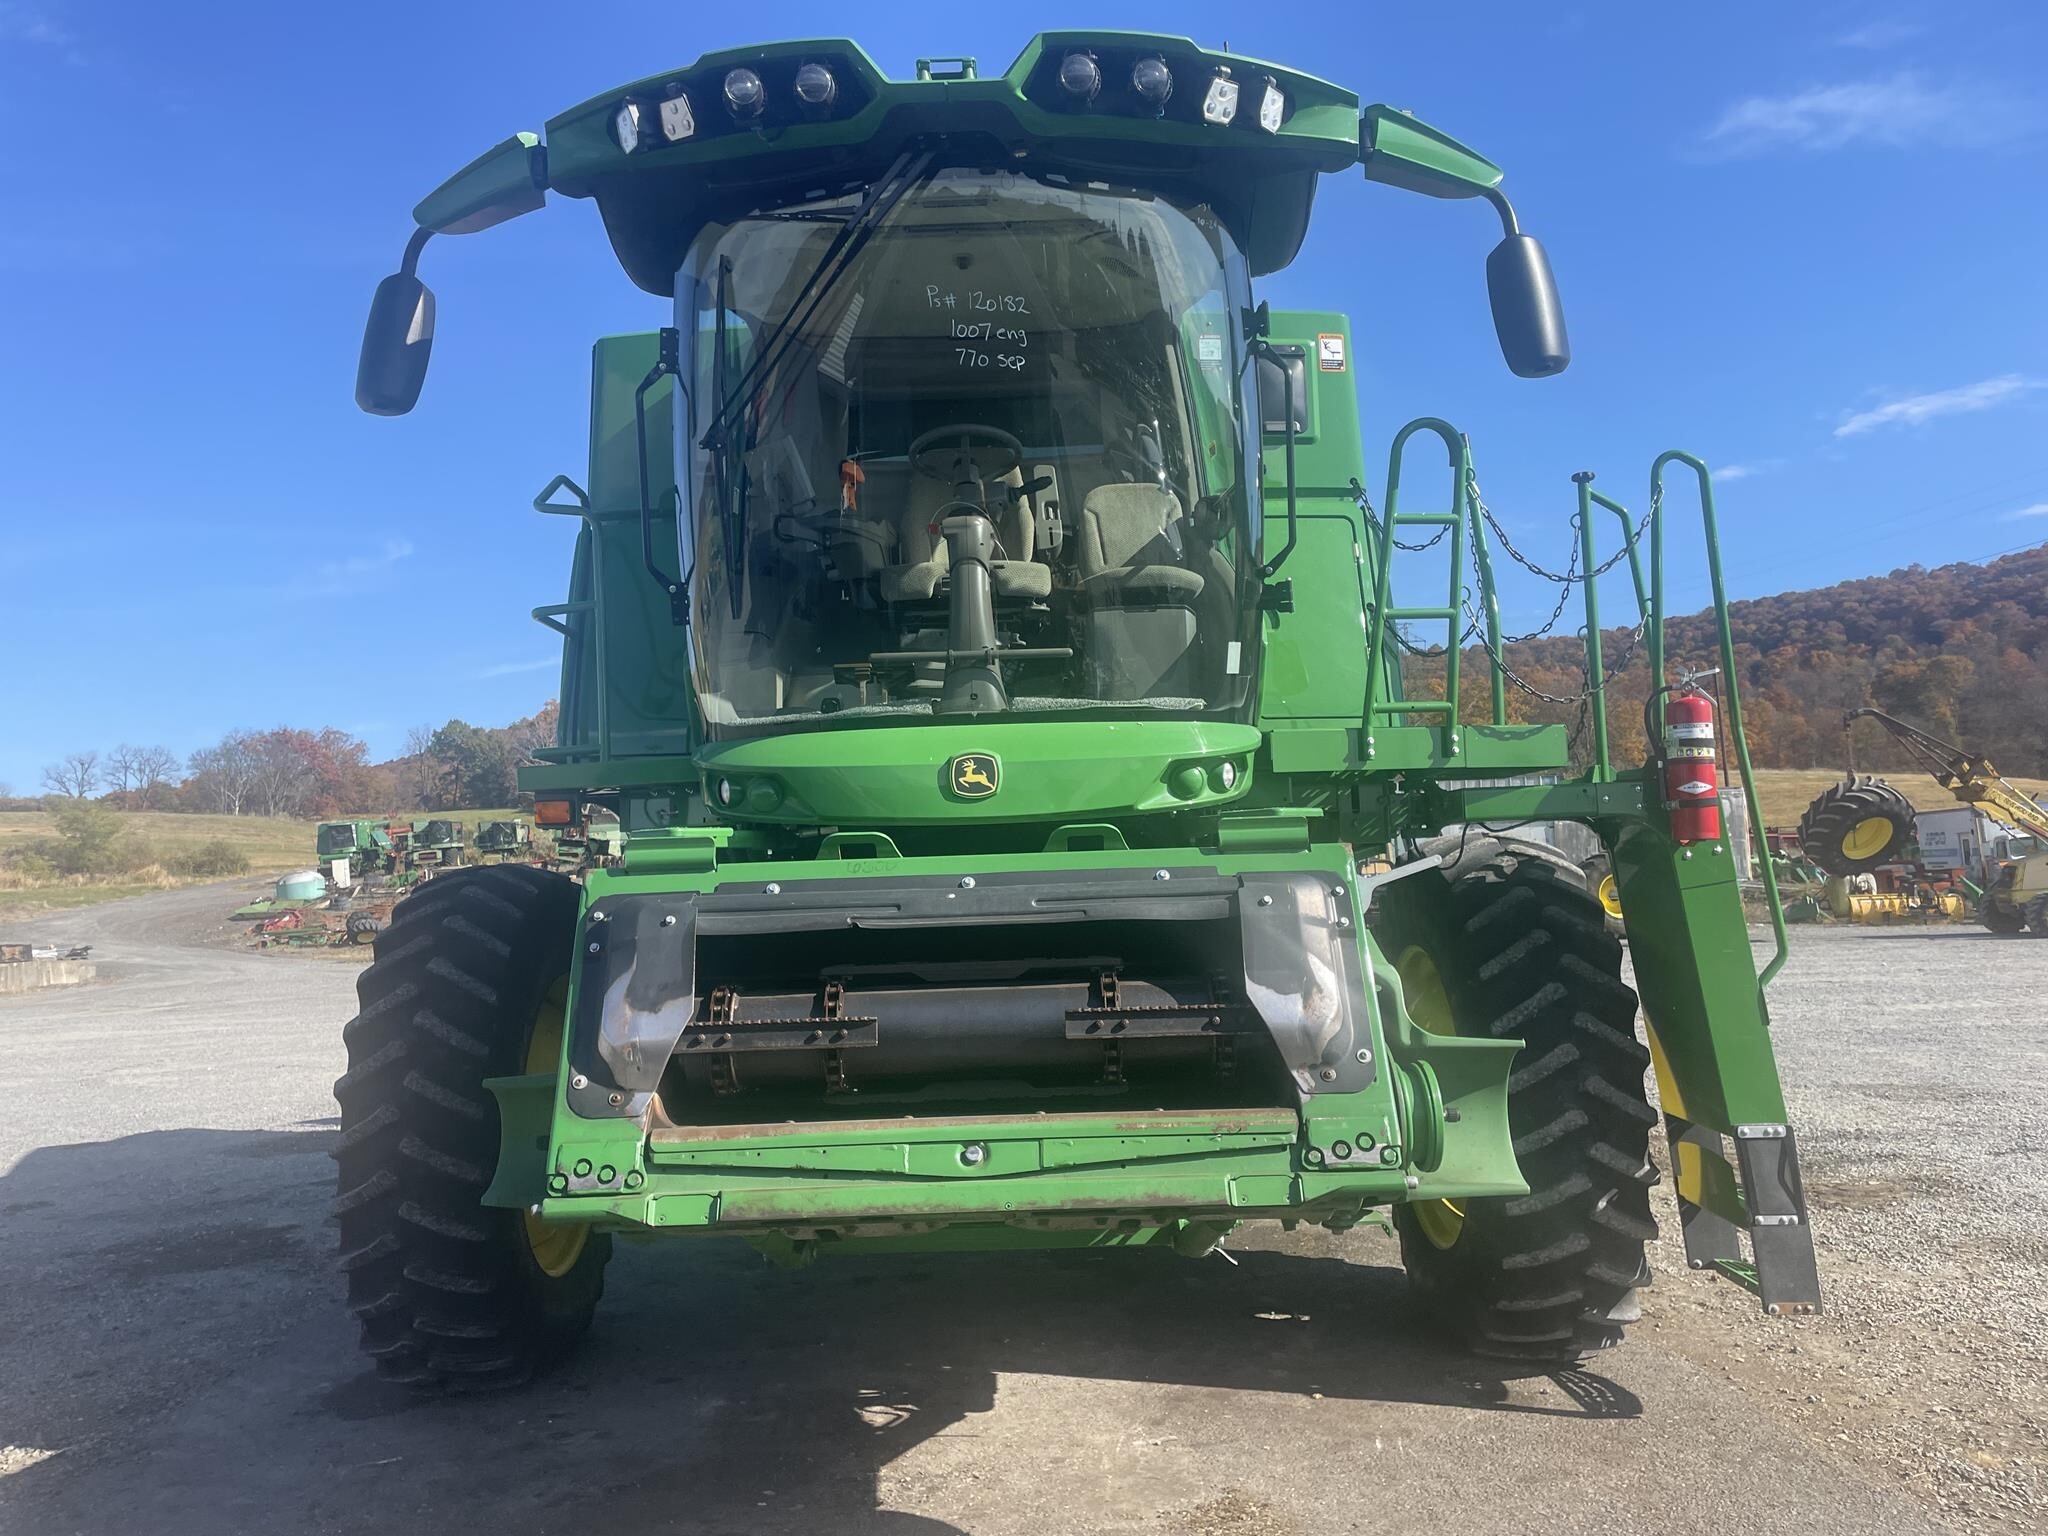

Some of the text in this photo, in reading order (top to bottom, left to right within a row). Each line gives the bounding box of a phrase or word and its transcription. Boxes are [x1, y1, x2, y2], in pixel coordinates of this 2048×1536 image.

[968, 291, 1031, 314] 120182
[951, 319, 1028, 347] 1007 eng
[955, 348, 989, 367] 770
